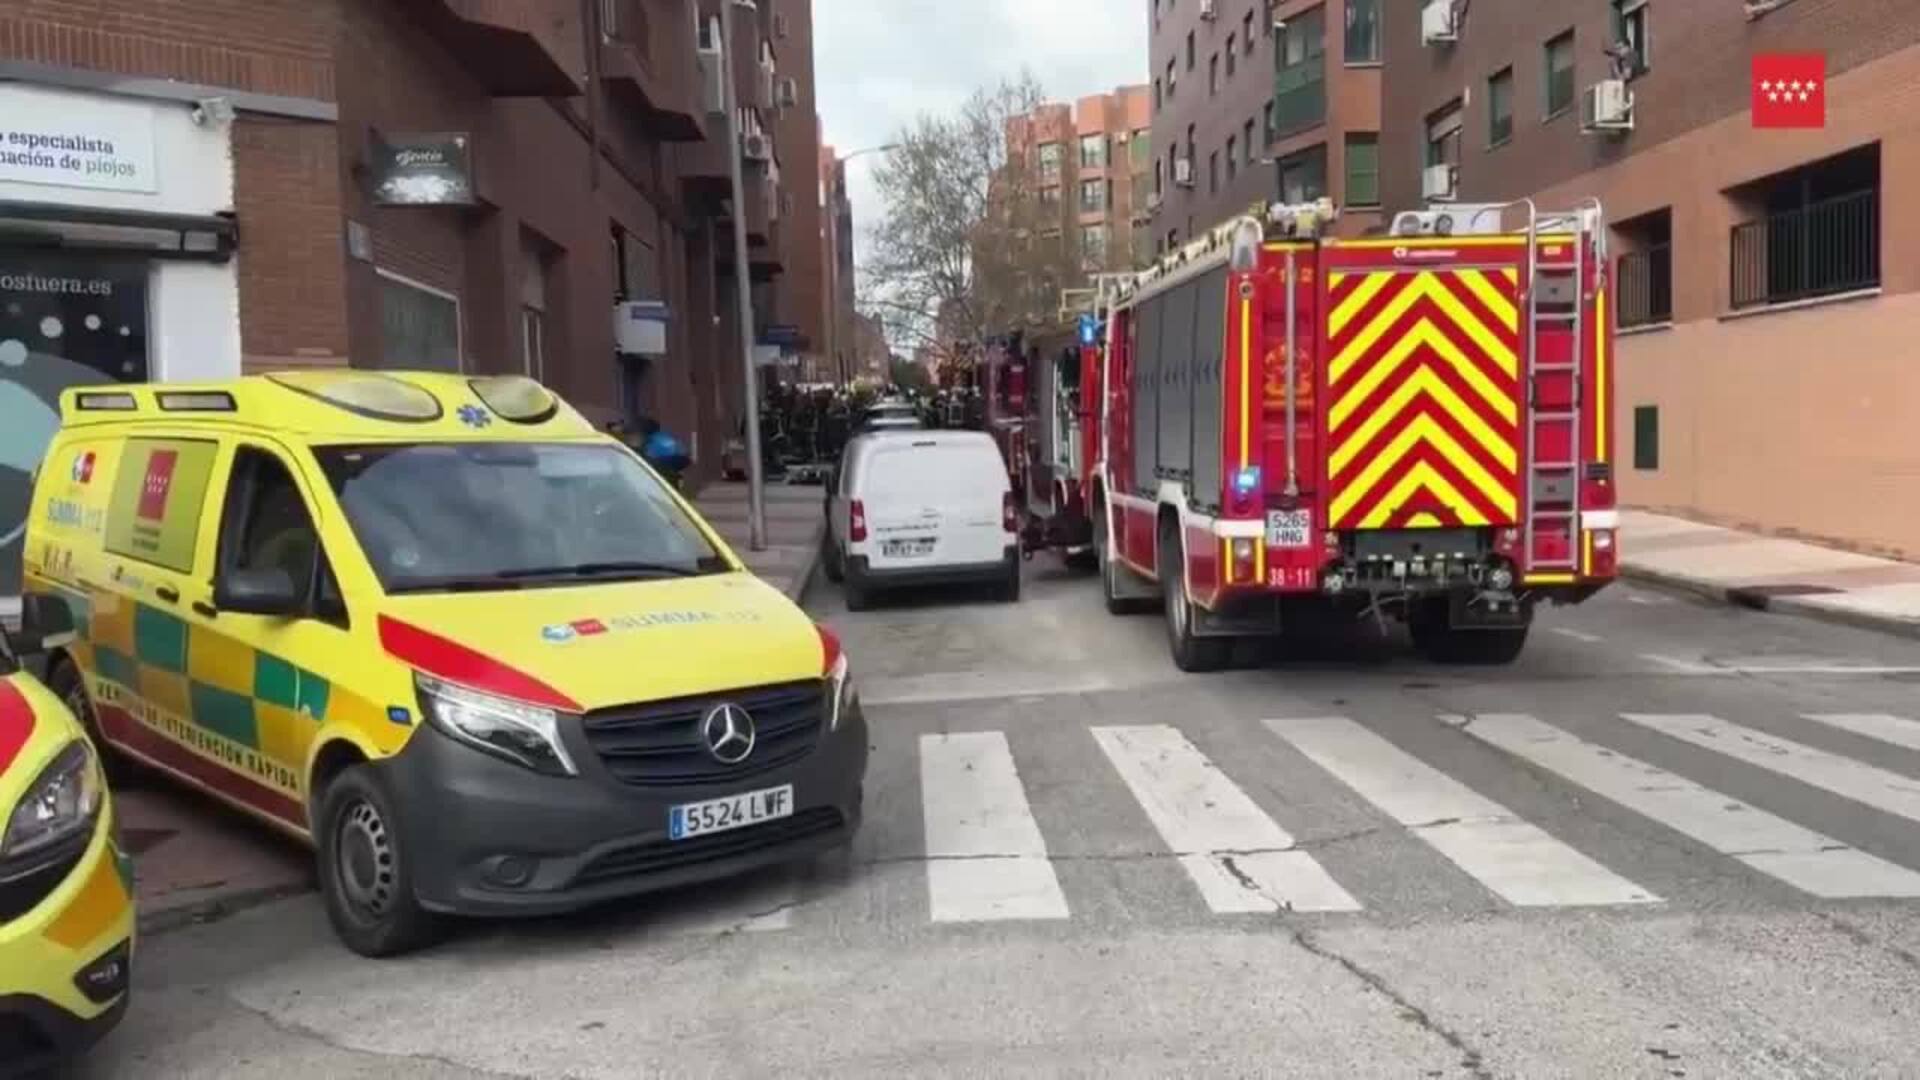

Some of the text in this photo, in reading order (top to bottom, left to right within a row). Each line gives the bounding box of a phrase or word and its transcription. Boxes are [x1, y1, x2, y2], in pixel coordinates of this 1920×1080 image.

[8, 131, 114, 155] especialista
[60, 154, 80, 171] de
[86, 156, 136, 178] piojos
[1272, 512, 1309, 529] 5265
[1275, 528, 1303, 544] HNG
[687, 788, 788, 832] 5524 LWF
